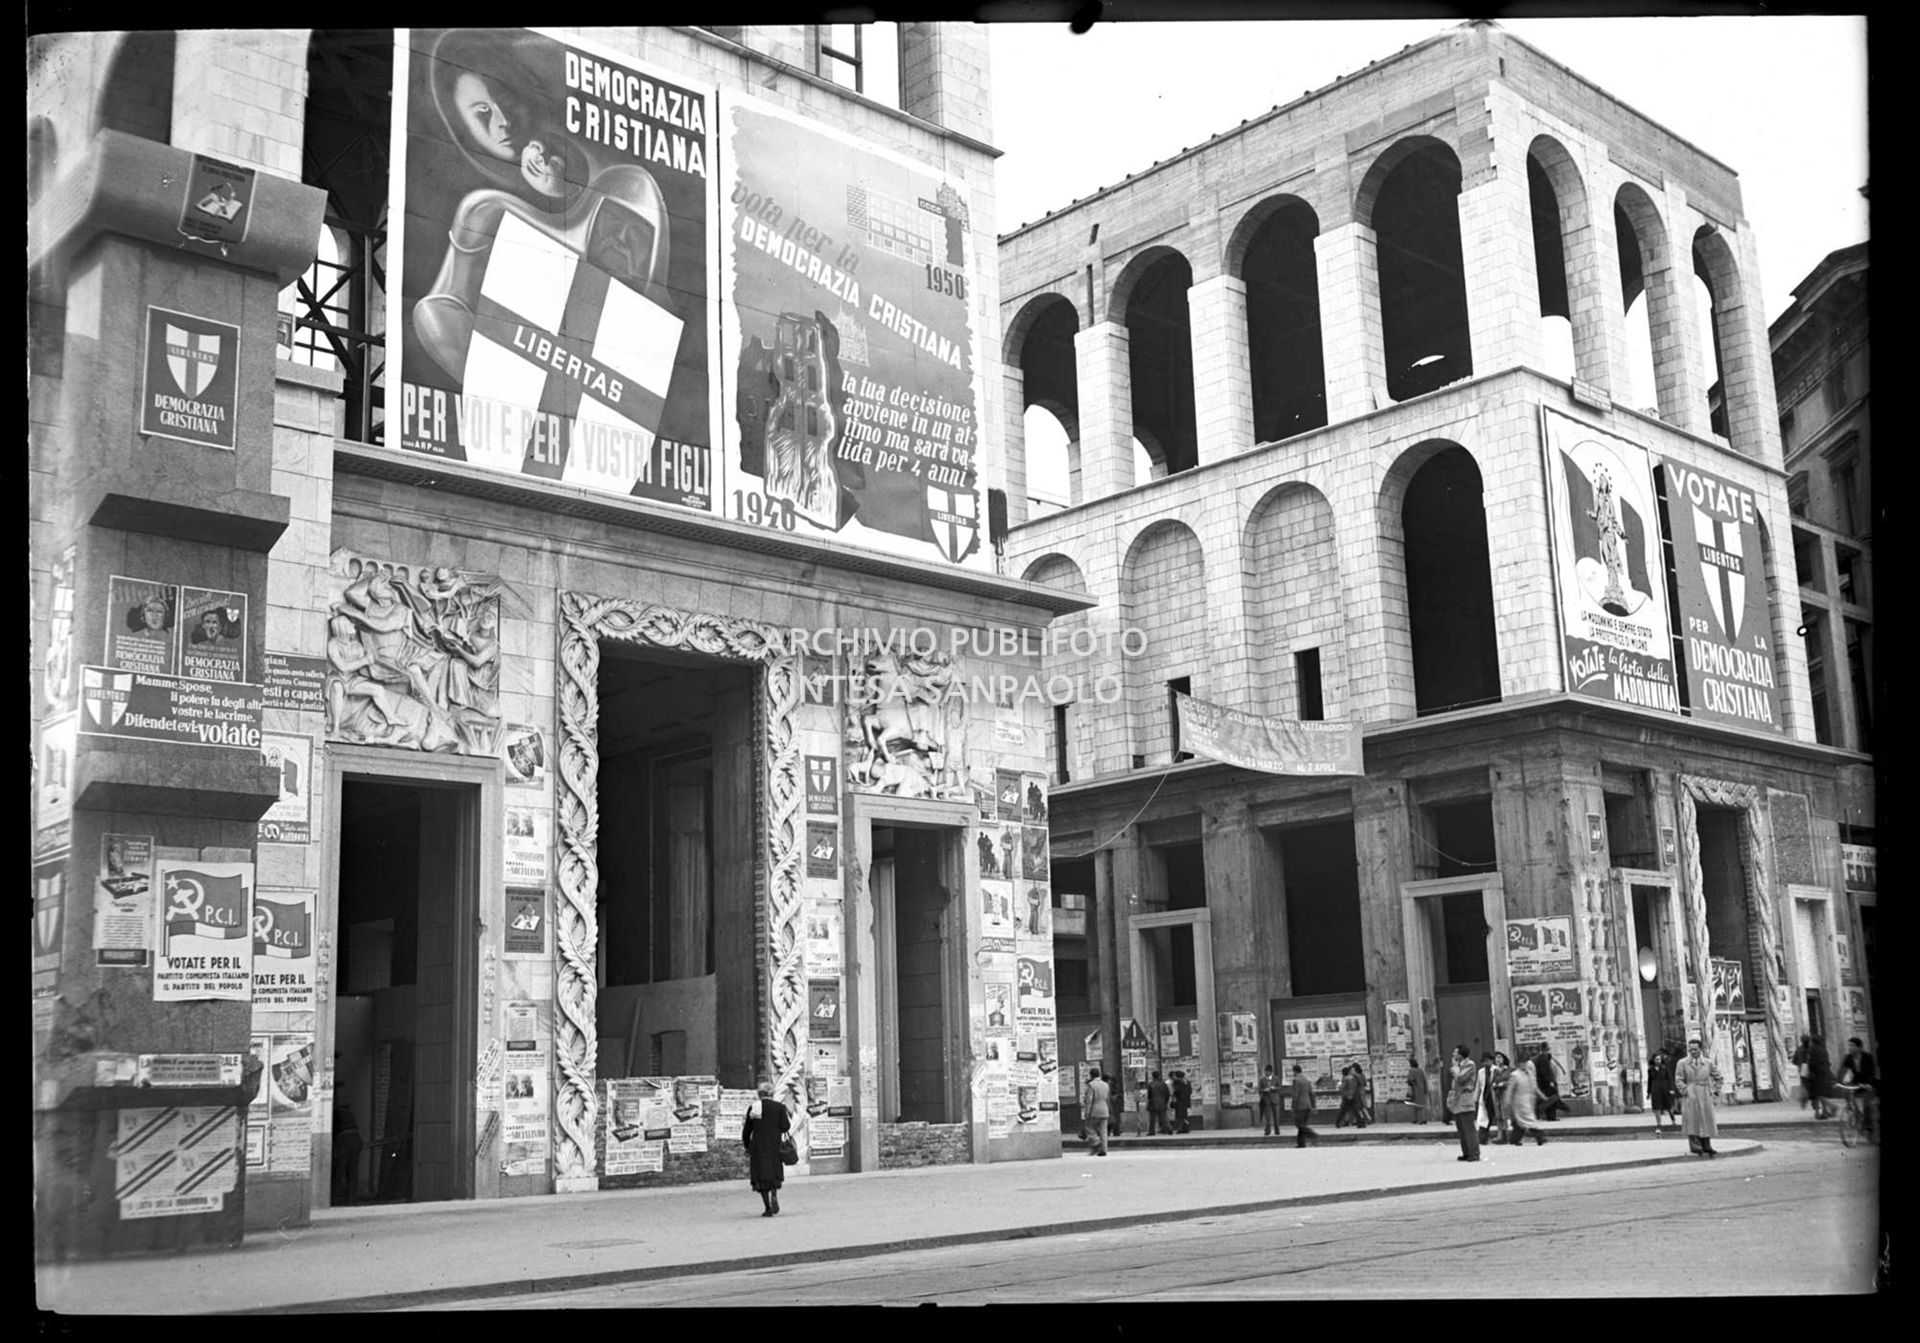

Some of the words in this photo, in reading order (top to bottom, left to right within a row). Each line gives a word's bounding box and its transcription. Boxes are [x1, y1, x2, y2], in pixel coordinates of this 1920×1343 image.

[565, 51, 705, 135] DEMOCRAZIA
[566, 96, 706, 178] CRISTIANA
[730, 180, 783, 229] vota
[783, 216, 832, 253] per
[835, 243, 860, 276] la
[740, 216, 859, 308] DEMOCRAZIA
[869, 293, 962, 370] CRISTIANA
[925, 264, 965, 300] 1950
[513, 325, 623, 403] LIBERTAS
[154, 393, 225, 421] DEMOCRAZIA
[841, 370, 856, 394] la
[860, 376, 885, 402] tua
[890, 386, 971, 424] decisione
[160, 411, 218, 435] CRISTIANA
[843, 397, 908, 430] avviene
[911, 414, 929, 436] in
[931, 419, 952, 440] un
[844, 417, 881, 444] timo
[886, 429, 910, 451] ma
[403, 382, 447, 442] PER
[455, 393, 494, 451] VOI
[501, 402, 512, 453] E
[522, 407, 560, 466] PER
[583, 420, 653, 484] VOSTRI
[661, 439, 710, 496] FIGLI
[837, 435, 872, 465] lida
[874, 452, 909, 473] per
[911, 460, 922, 477] 4
[928, 462, 967, 487] anni
[1668, 463, 1754, 525] VOTATE
[1702, 547, 1740, 571] LIBERTAS
[1689, 617, 1709, 634] PER
[1754, 635, 1767, 650] LA
[120, 660, 160, 673] CRISTIANA
[184, 655, 240, 671] DEMOCRAZIA
[190, 667, 235, 681] CRISTIANA
[1569, 646, 1606, 686] VOTATE
[1608, 647, 1618, 665] la
[1618, 652, 1644, 677] lista
[1647, 662, 1669, 683] della
[1690, 637, 1775, 689] DEMOCRAZIA
[179, 694, 209, 706] potere
[211, 695, 221, 706] fu
[222, 697, 245, 710] degli
[1613, 673, 1679, 713] MADONNINA
[1703, 678, 1773, 724] CRISTIANA
[171, 707, 203, 718] vostre
[204, 708, 213, 719] le
[199, 722, 261, 747] votate
[205, 905, 238, 926] P.C.I.
[274, 929, 302, 947] P.C.I.
[167, 957, 206, 970] VOTATE
[210, 957, 230, 969] PER
[232, 957, 241, 969] IL
[280, 974, 296, 984] PER
[298, 974, 306, 984] IL
[218, 982, 243, 990] POPOLO
